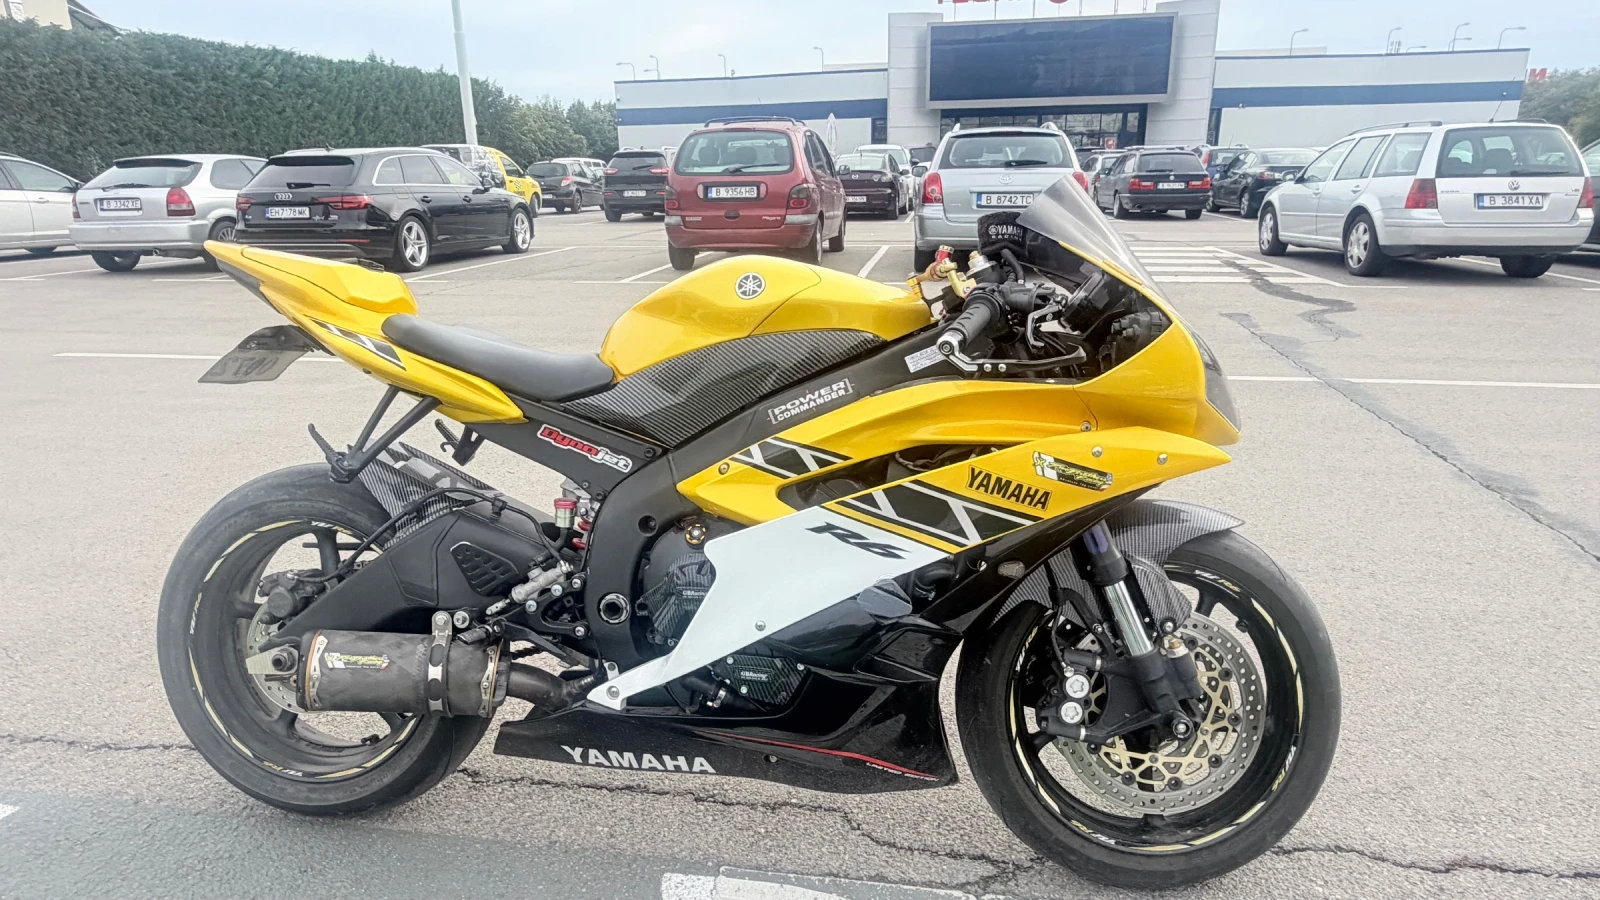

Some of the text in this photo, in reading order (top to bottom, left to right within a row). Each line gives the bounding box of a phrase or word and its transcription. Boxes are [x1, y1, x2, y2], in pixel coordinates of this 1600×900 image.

[106, 200, 139, 208] B 3342 XE
[715, 186, 755, 197] B 9356 HB
[986, 195, 1032, 205] B 8742 TC
[1489, 196, 1541, 205] B 3841 XA
[773, 381, 846, 415] POWER
[776, 389, 846, 421] COMMANDER
[967, 467, 1051, 510] YAMAHA
[805, 520, 912, 560] R6
[560, 745, 717, 773] YAMAHA
